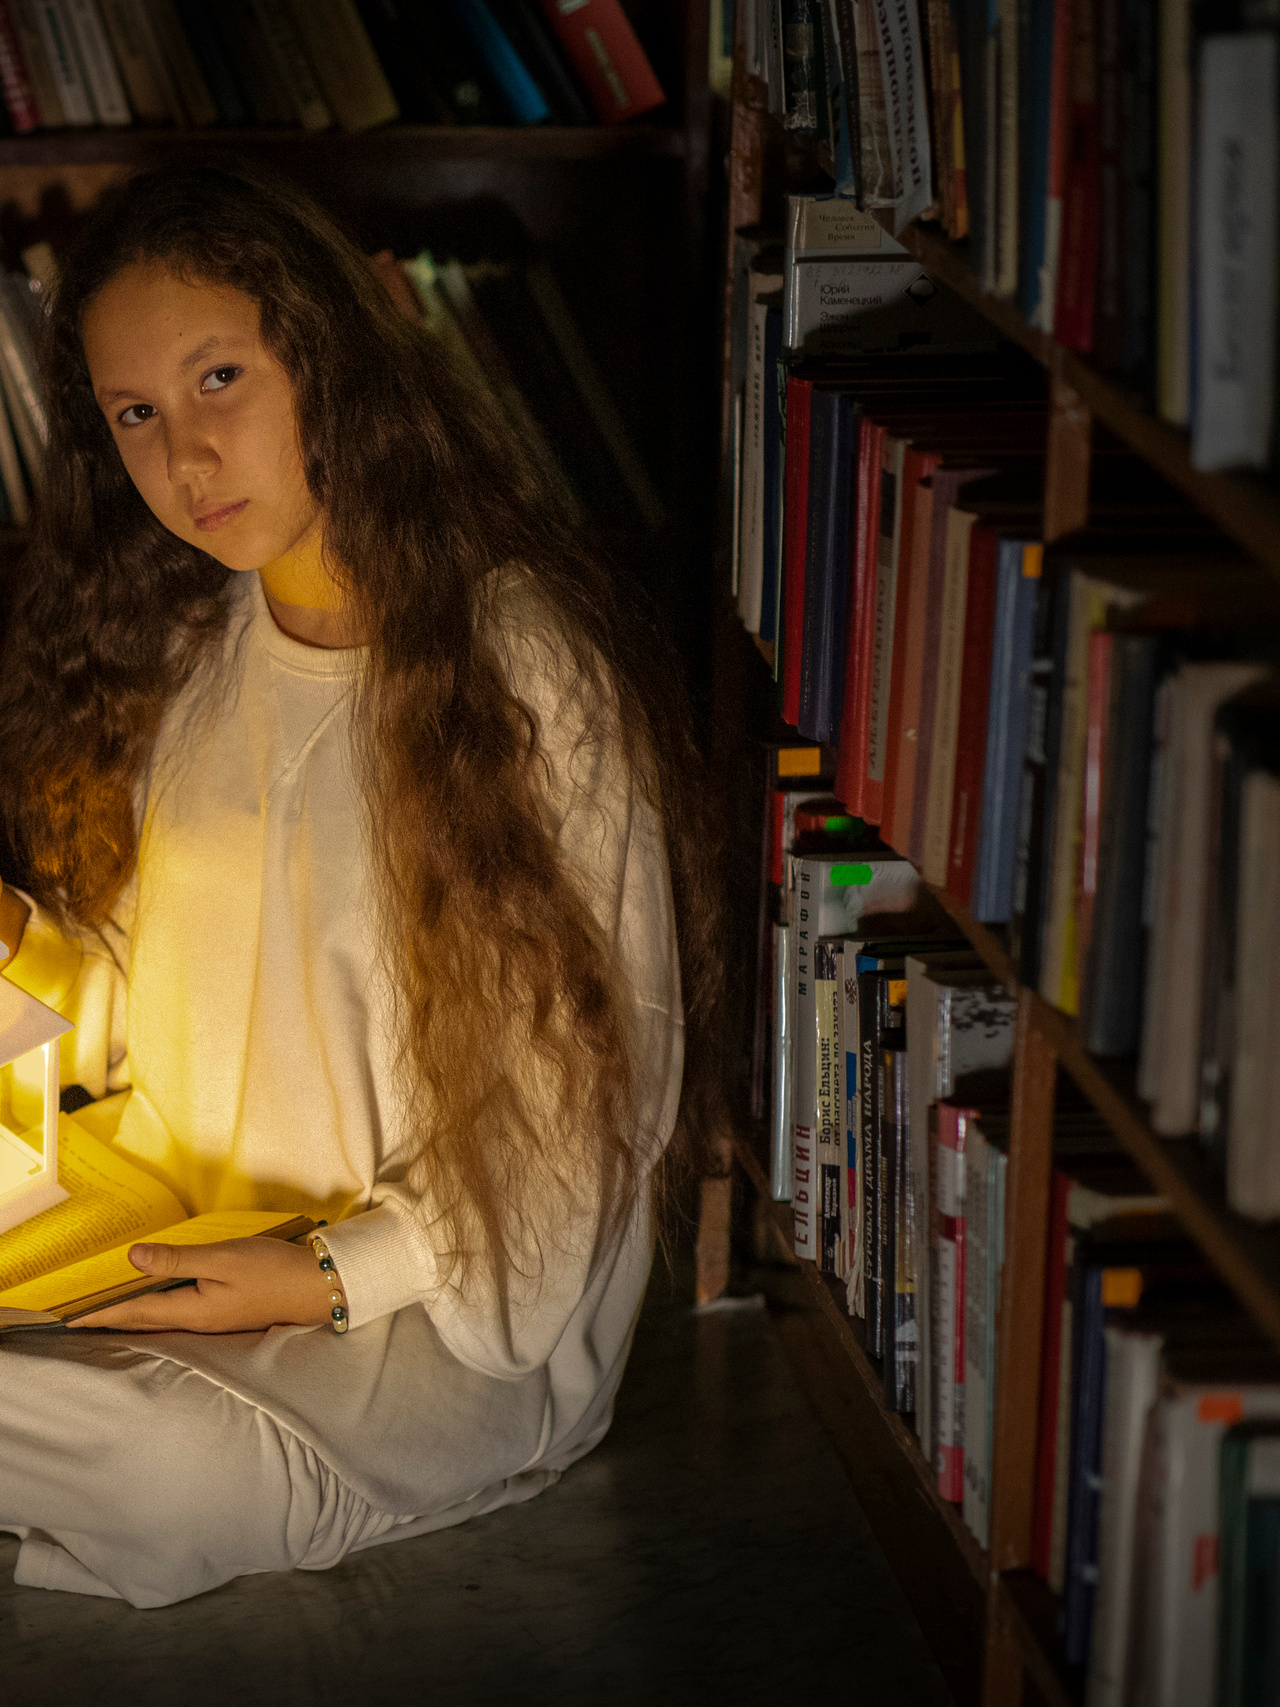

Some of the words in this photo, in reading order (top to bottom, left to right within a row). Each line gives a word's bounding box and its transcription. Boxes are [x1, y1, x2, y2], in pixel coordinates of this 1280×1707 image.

[819, 214, 855, 222] Человек
[835, 223, 875, 231] События
[827, 233, 856, 242] Время
[820, 284, 850, 295] Юрий
[820, 296, 882, 306] Каменецкий
[798, 872, 811, 996] МАРАФОН
[820, 1037, 833, 1097] Ельцин:
[863, 1039, 874, 1117] НАРОДА
[820, 1112, 834, 1145] Борис
[833, 1130, 841, 1147] от
[863, 1123, 874, 1190] ДРАМА
[795, 1124, 811, 1246] ЕЛЬЦИН
[864, 1195, 873, 1280] СУРОВАЯ
